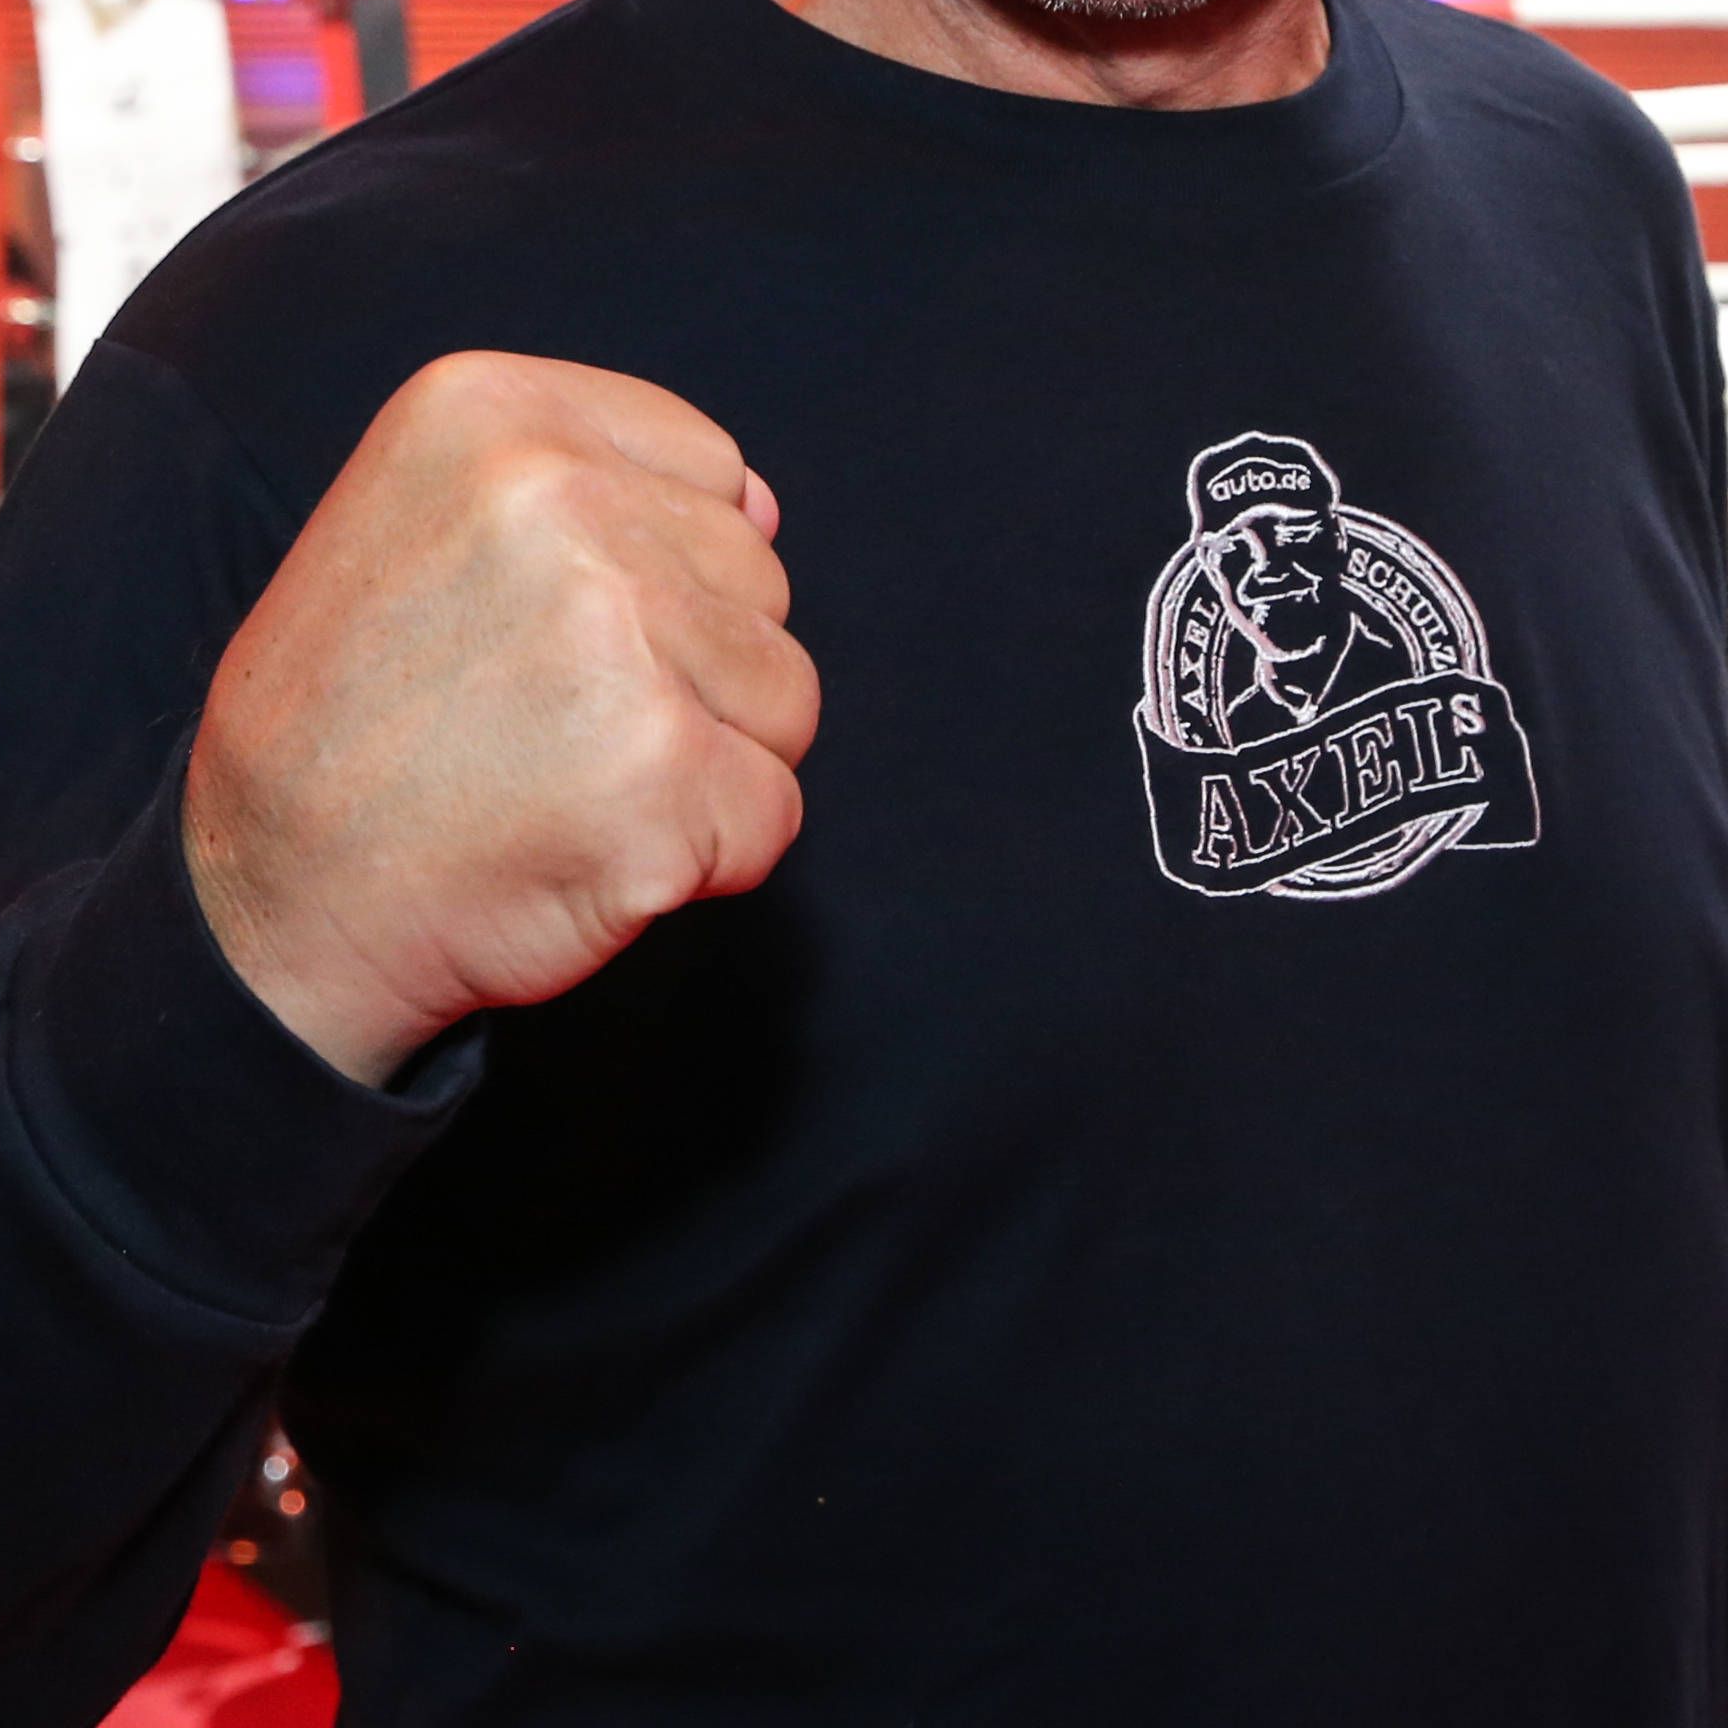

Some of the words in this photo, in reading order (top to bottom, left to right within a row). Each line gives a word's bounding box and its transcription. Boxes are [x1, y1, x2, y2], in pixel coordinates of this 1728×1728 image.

[1210, 468, 1312, 502] auto.de
[1181, 597, 1221, 716] AXEL
[1347, 547, 1458, 672] SCHULZ
